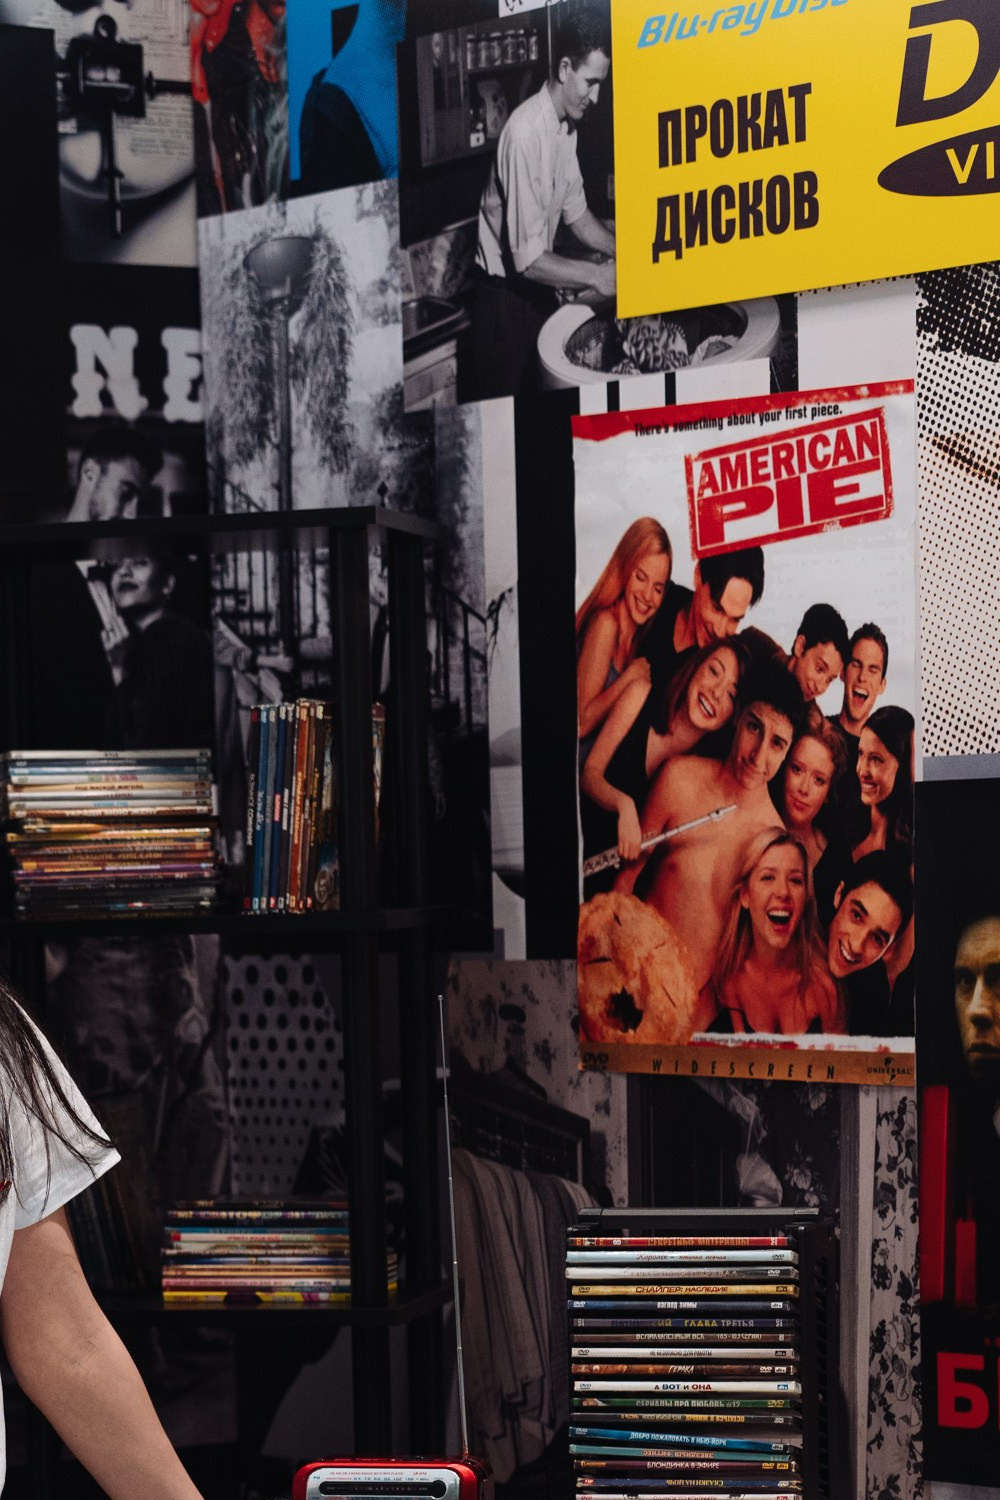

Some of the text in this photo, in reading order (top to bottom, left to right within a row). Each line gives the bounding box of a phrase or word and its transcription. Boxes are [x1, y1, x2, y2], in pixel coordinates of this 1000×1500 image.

[657, 81, 813, 169] ПРОКАТ
[651, 170, 820, 264] ДИСКОВ
[634, 403, 843, 438] There's something about your first piece.
[698, 420, 882, 498] AMERICAN
[697, 456, 885, 548] PIE
[651, 1057, 837, 1080] WIDESCREEN
[866, 1065, 913, 1076] UNIVERSAL
[635, 1285, 684, 1294] СНАЙПЕР:
[684, 1319, 755, 1328] ГЛАВА ТРЕТЬЯ
[662, 1383, 680, 1391] ВОТ
[691, 1383, 712, 1391] ОНА
[635, 1400, 673, 1408] СЕРИАЛЫ
[673, 1400, 690, 1408] ПРО
[691, 1400, 725, 1408] ЛЮБОВЬ
[629, 1431, 650, 1440] ДОБРО
[650, 1432, 690, 1443] ПОЖАЛОВАТЬ
[696, 1436, 727, 1446] НЬЮ-ЙОРК
[646, 1461, 690, 1470] БЛОНДИНКА
